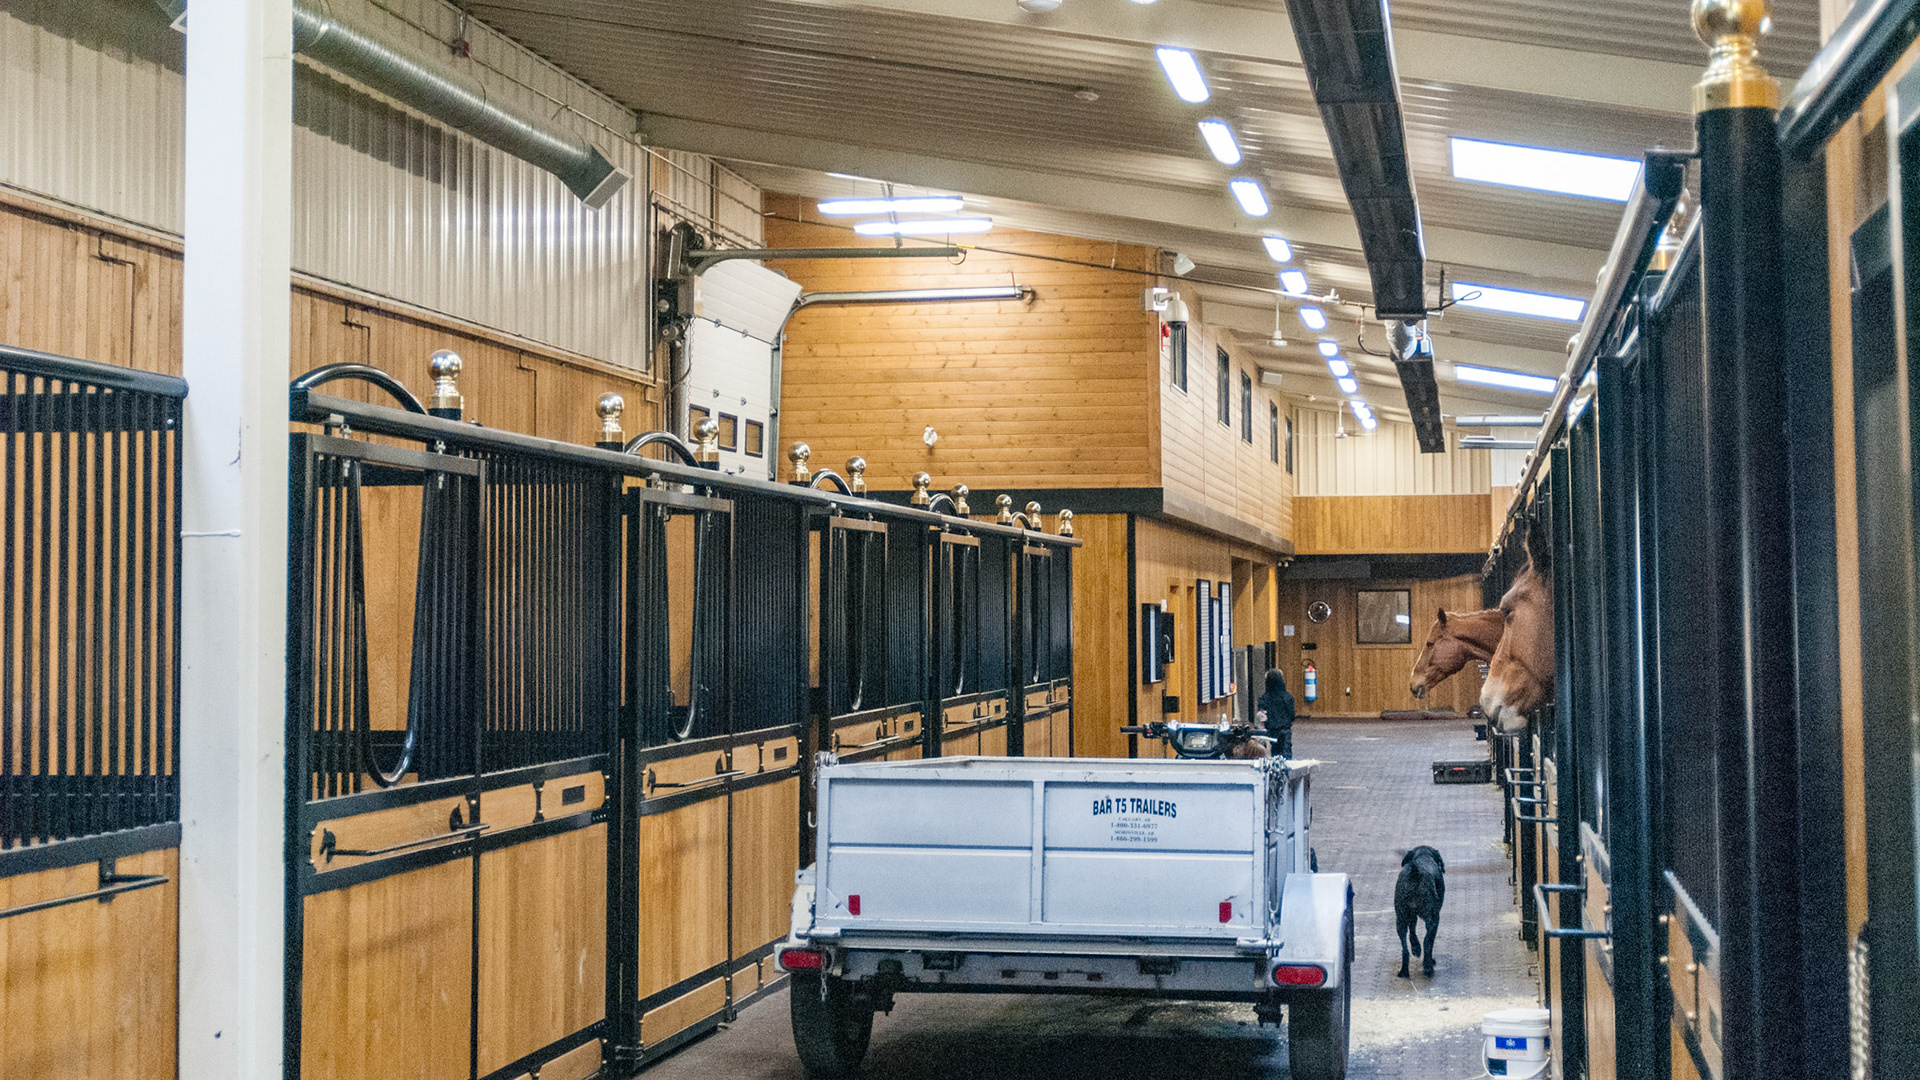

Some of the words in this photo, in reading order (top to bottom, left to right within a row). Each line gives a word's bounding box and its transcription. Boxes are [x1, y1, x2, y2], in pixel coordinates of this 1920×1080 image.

[1093, 799, 1112, 815] BAR
[1115, 798, 1127, 814] T5
[1130, 798, 1177, 818] TRAILERS
